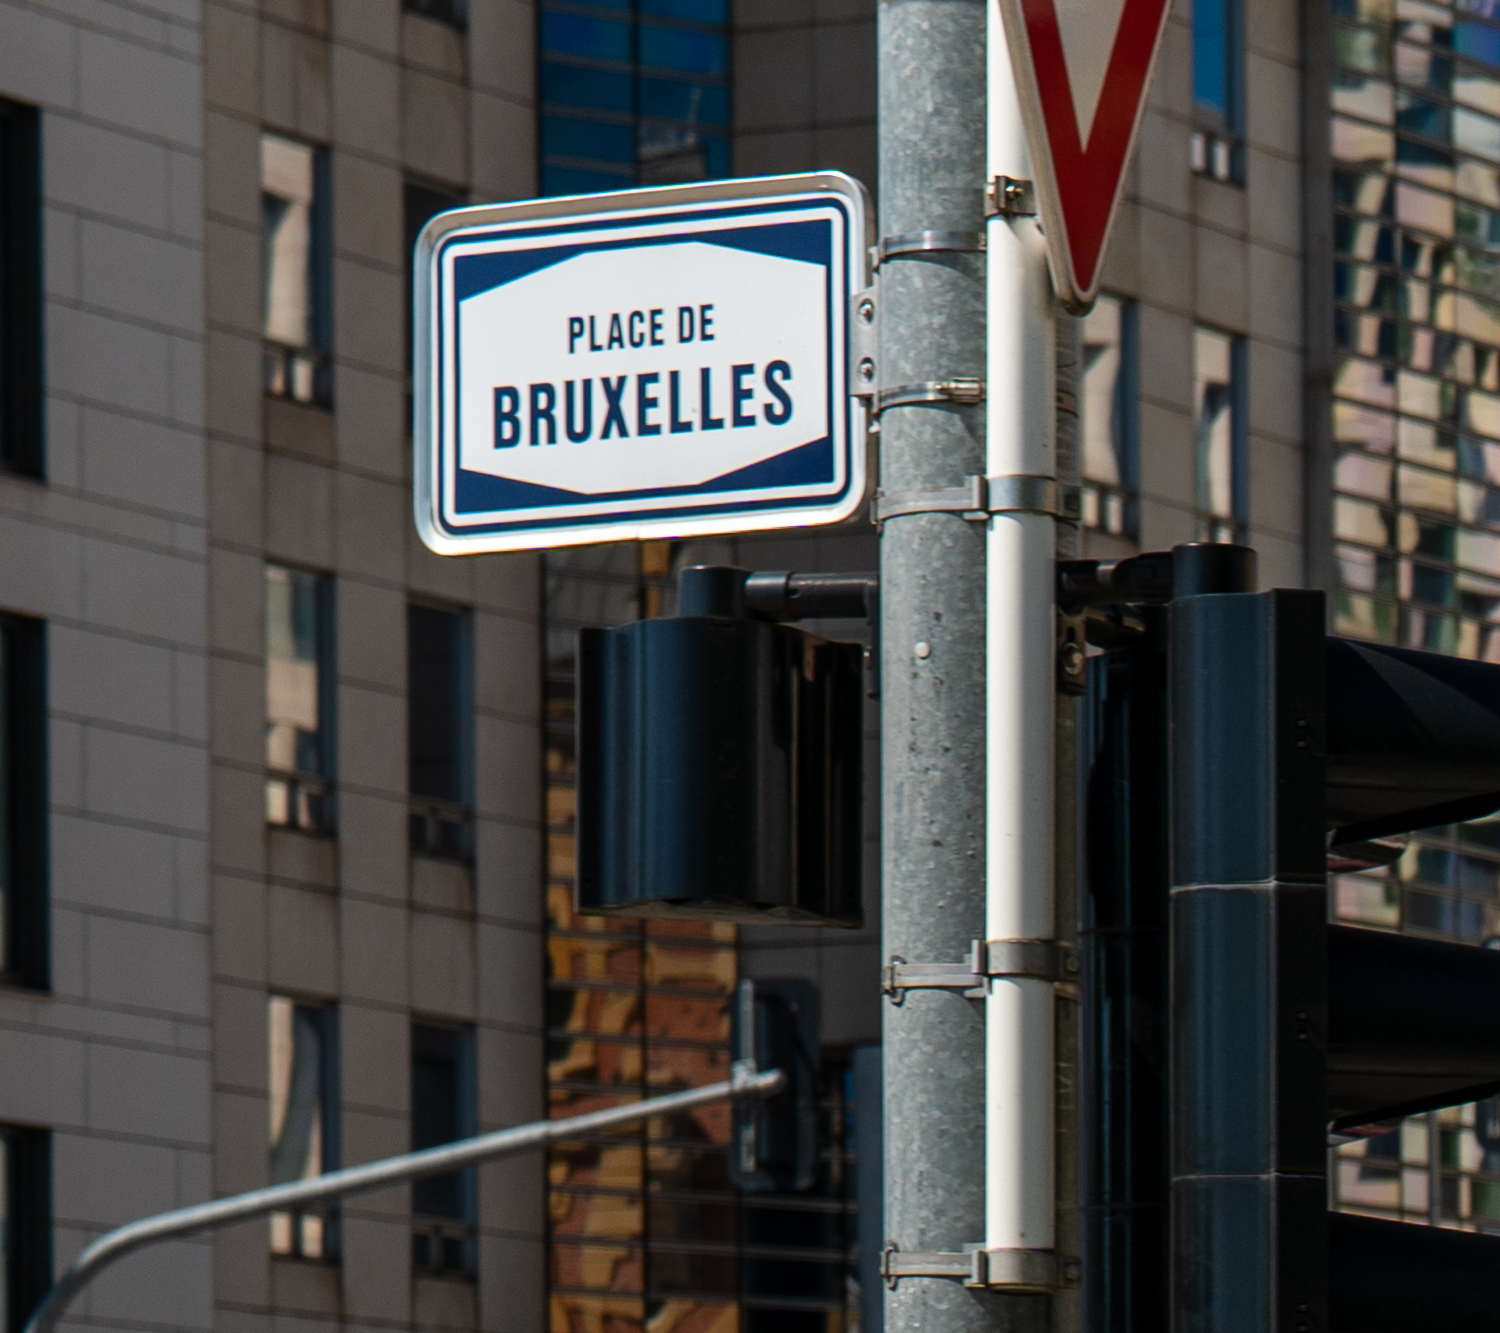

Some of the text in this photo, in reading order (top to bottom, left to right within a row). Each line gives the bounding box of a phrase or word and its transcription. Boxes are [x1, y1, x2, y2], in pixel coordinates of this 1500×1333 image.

[568, 305, 715, 353] PLACE DE
[493, 360, 793, 449] BRUXELLES
